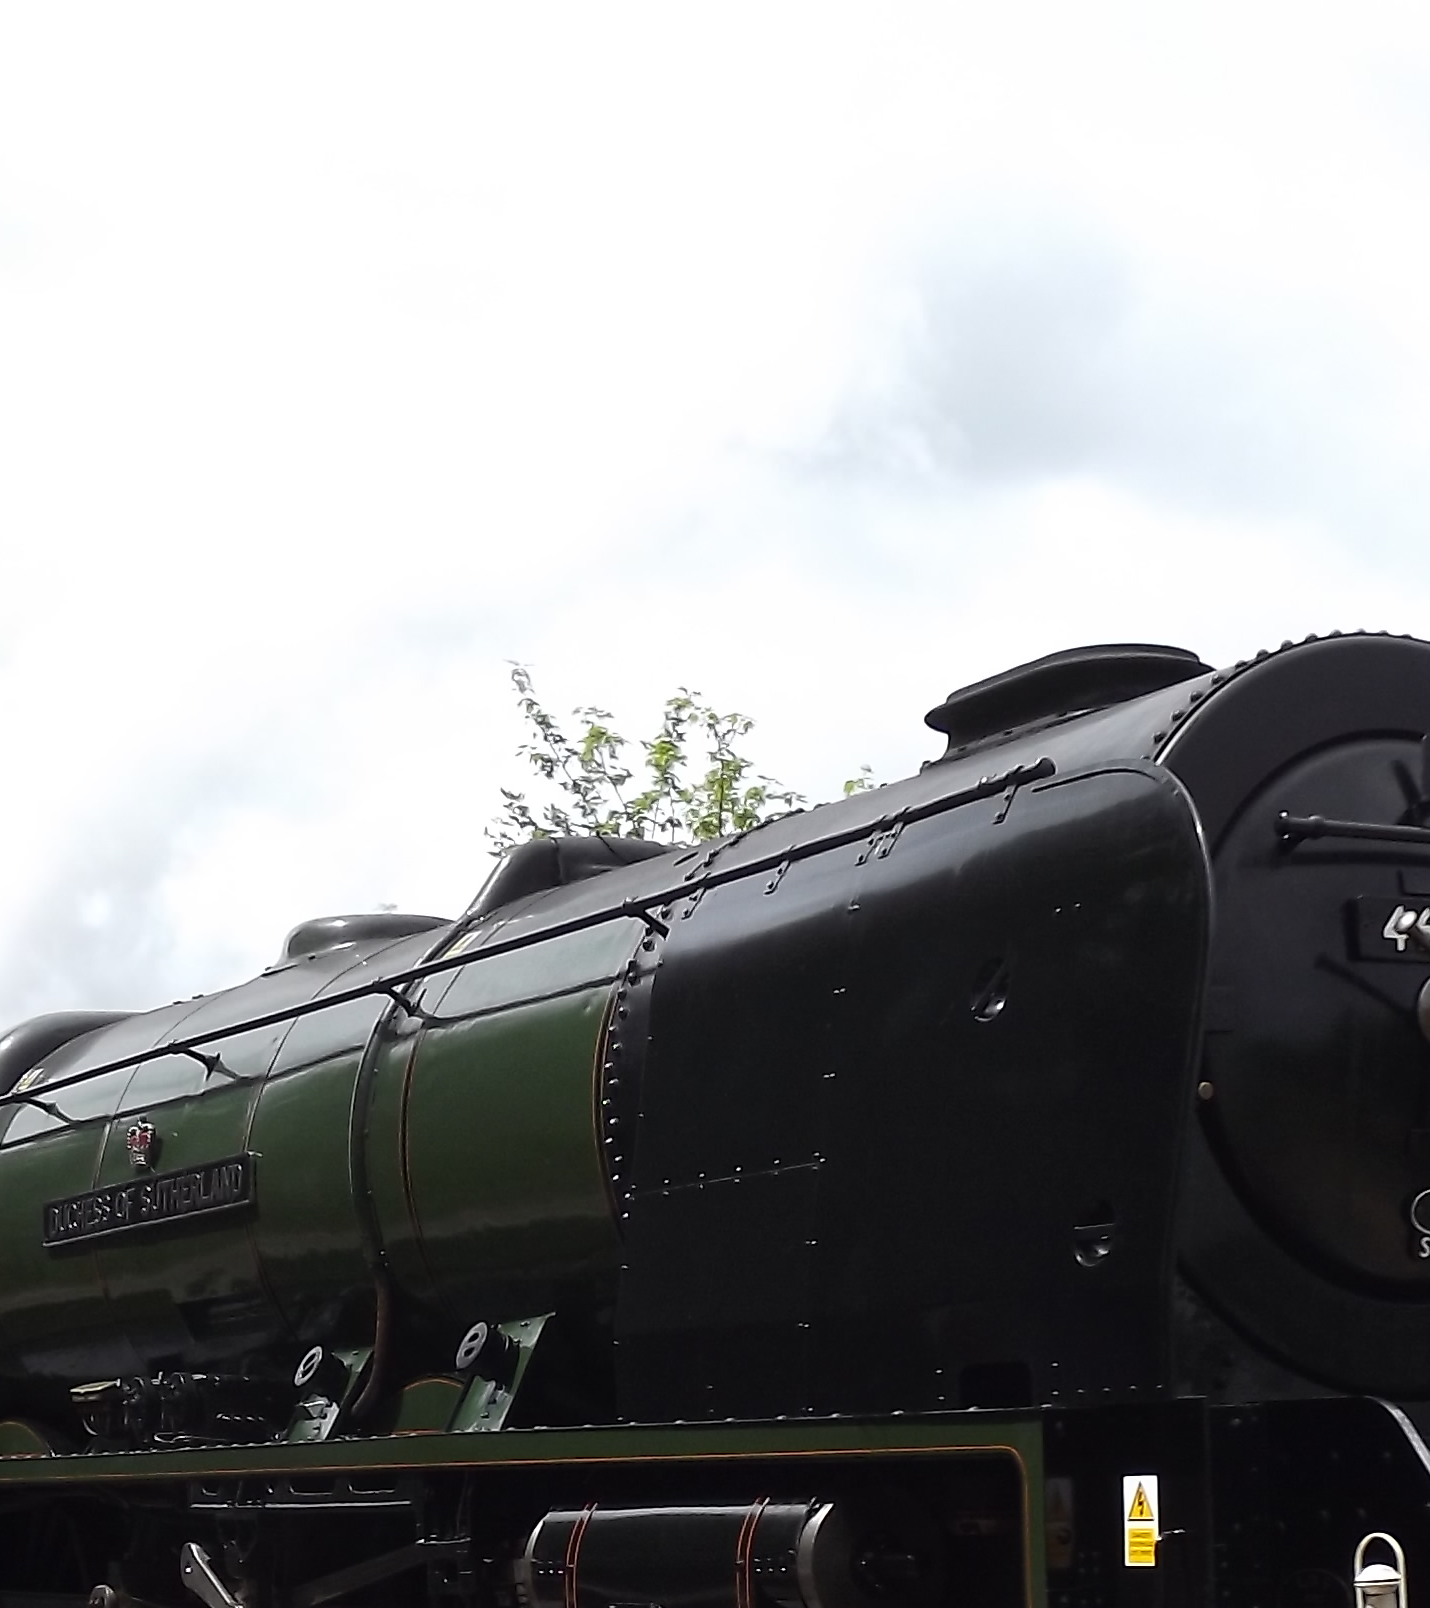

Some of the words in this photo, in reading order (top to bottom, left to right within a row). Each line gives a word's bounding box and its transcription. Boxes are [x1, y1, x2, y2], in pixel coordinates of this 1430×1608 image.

[51, 1194, 112, 1236] DUCHESS
[115, 1188, 136, 1221] OF
[140, 1162, 244, 1214] SUTHERLAND
